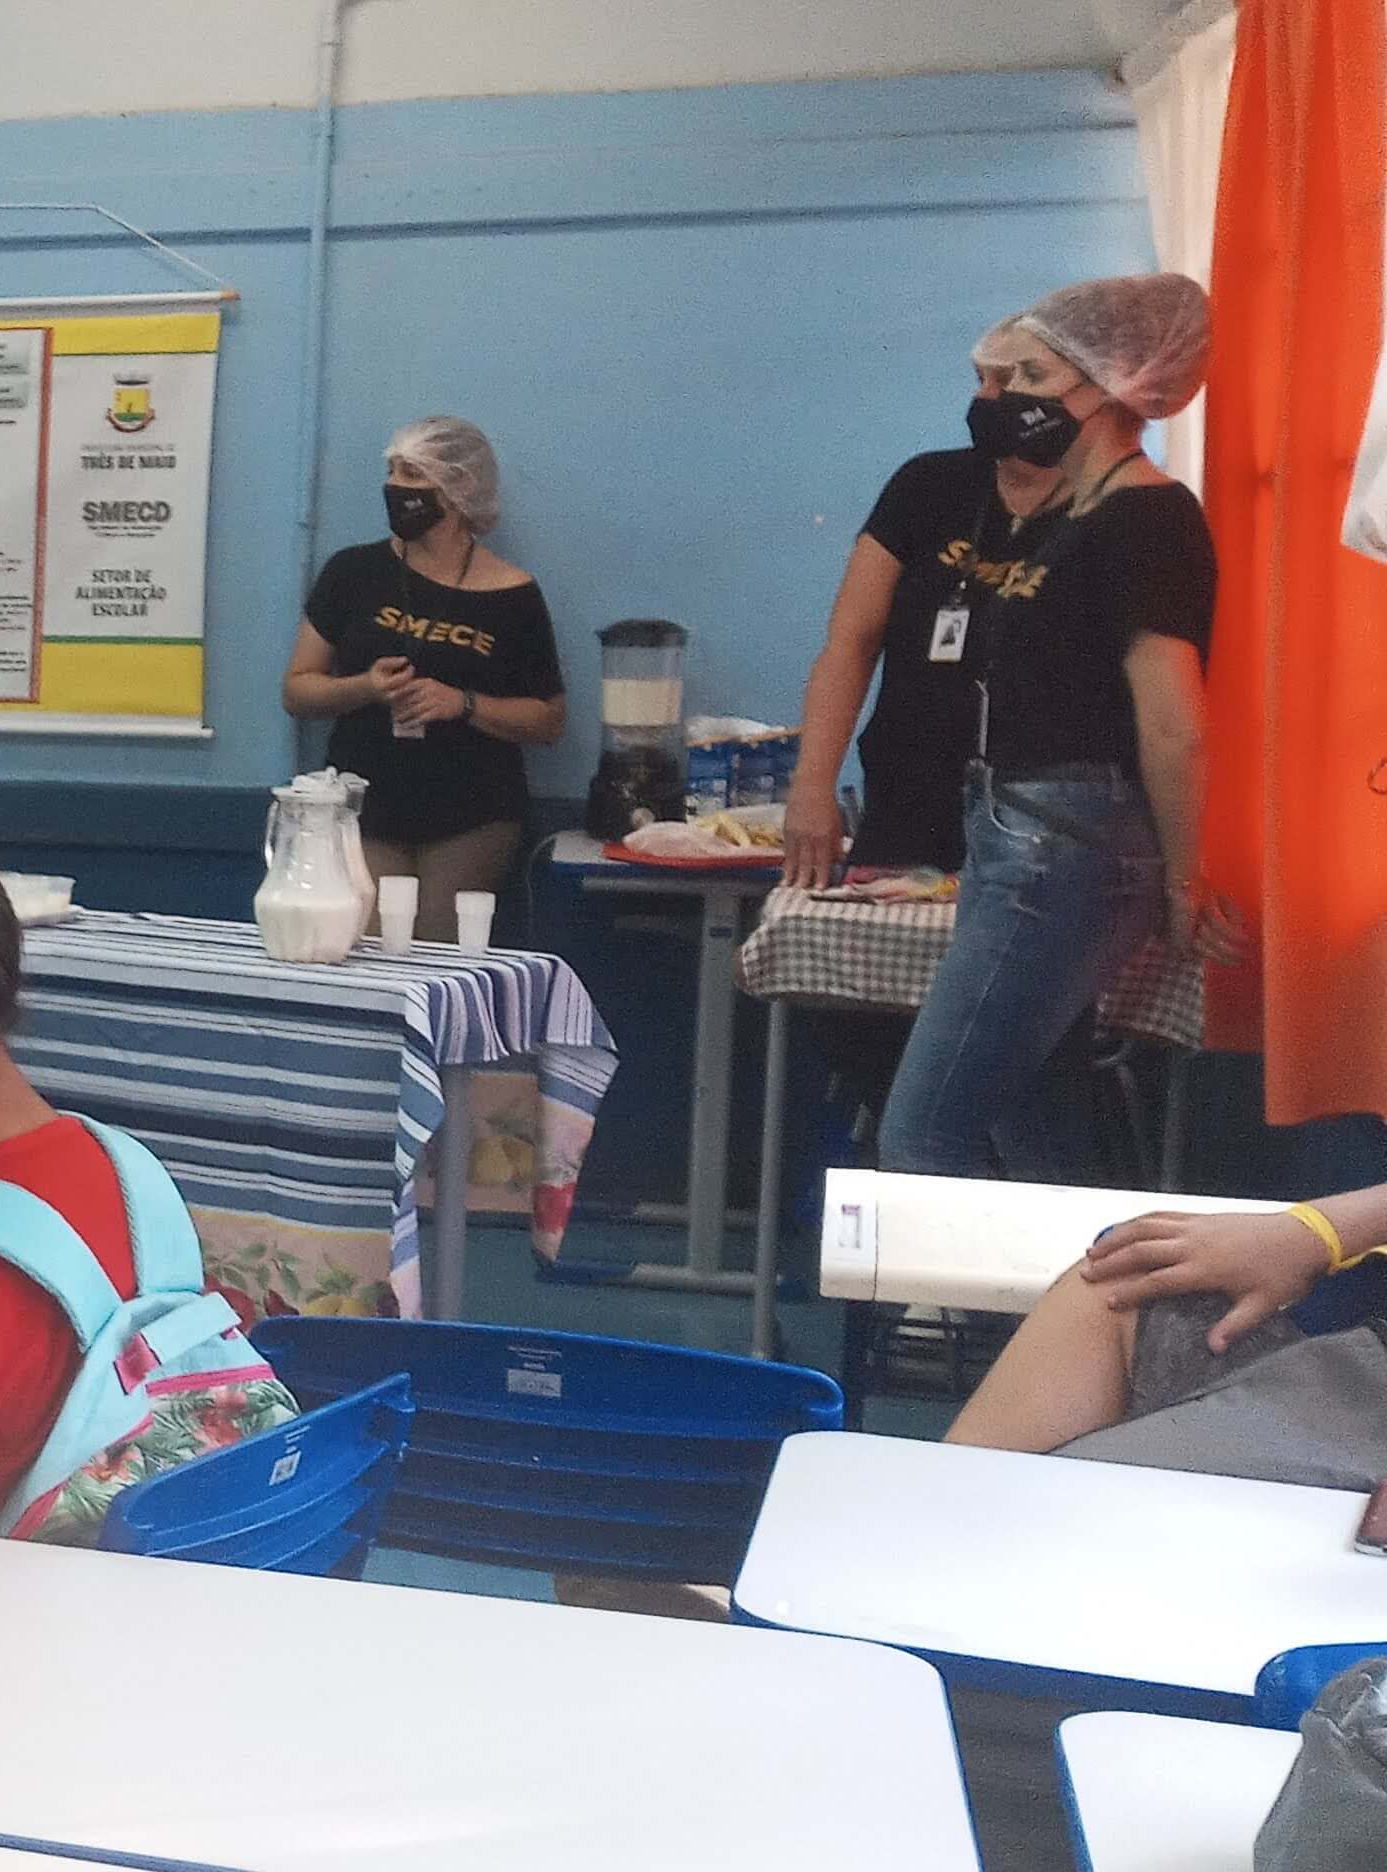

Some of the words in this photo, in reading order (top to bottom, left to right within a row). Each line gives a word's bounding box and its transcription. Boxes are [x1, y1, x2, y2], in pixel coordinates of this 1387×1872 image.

[82, 501, 171, 522] SMECD
[92, 569, 131, 583] SETOR
[134, 569, 152, 583] DE
[75, 584, 167, 600] ALIMENTAÇÃO
[92, 603, 148, 617] ESCOLAR
[374, 606, 495, 656] SMECE
